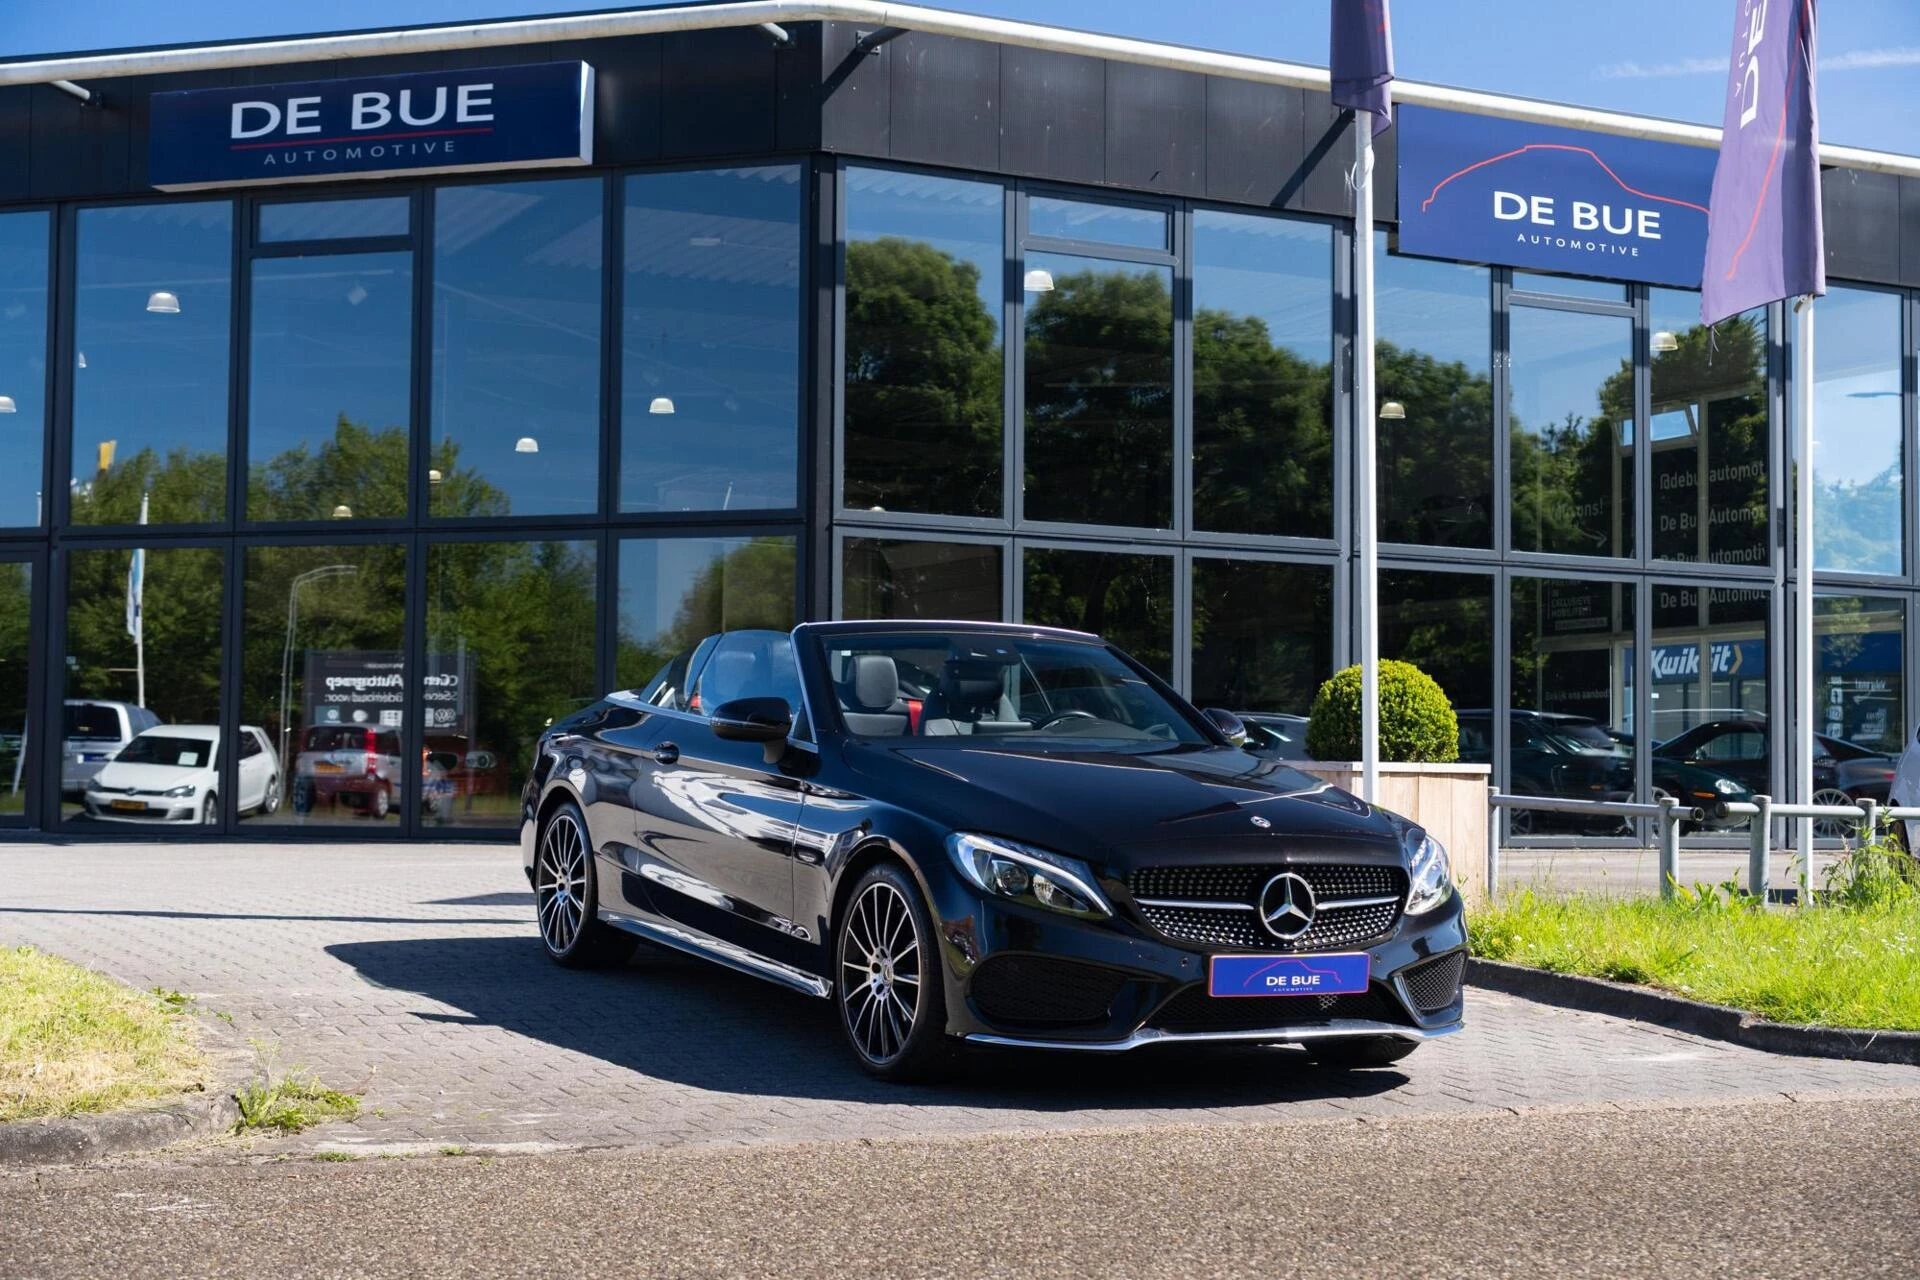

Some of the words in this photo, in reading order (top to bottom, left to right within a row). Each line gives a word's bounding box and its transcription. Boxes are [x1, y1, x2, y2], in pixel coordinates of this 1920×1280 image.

[1740, 0, 1768, 130] DE
[231, 96, 321, 139] DE
[351, 83, 494, 131] BUE
[263, 141, 455, 165] AUTOMOTIVE
[1494, 190, 1555, 226] DE
[1573, 201, 1662, 240] BUE
[1517, 233, 1639, 257] AUTOMOTIVE
[1660, 514, 1677, 532] De
[1680, 512, 1697, 530] Bu
[1708, 507, 1766, 525] Automot
[1660, 592, 1677, 609] De
[1680, 590, 1697, 607] Bu
[1651, 647, 1699, 679] Kwik
[1266, 976, 1287, 986] DE
[1291, 975, 1321, 986] BUE
